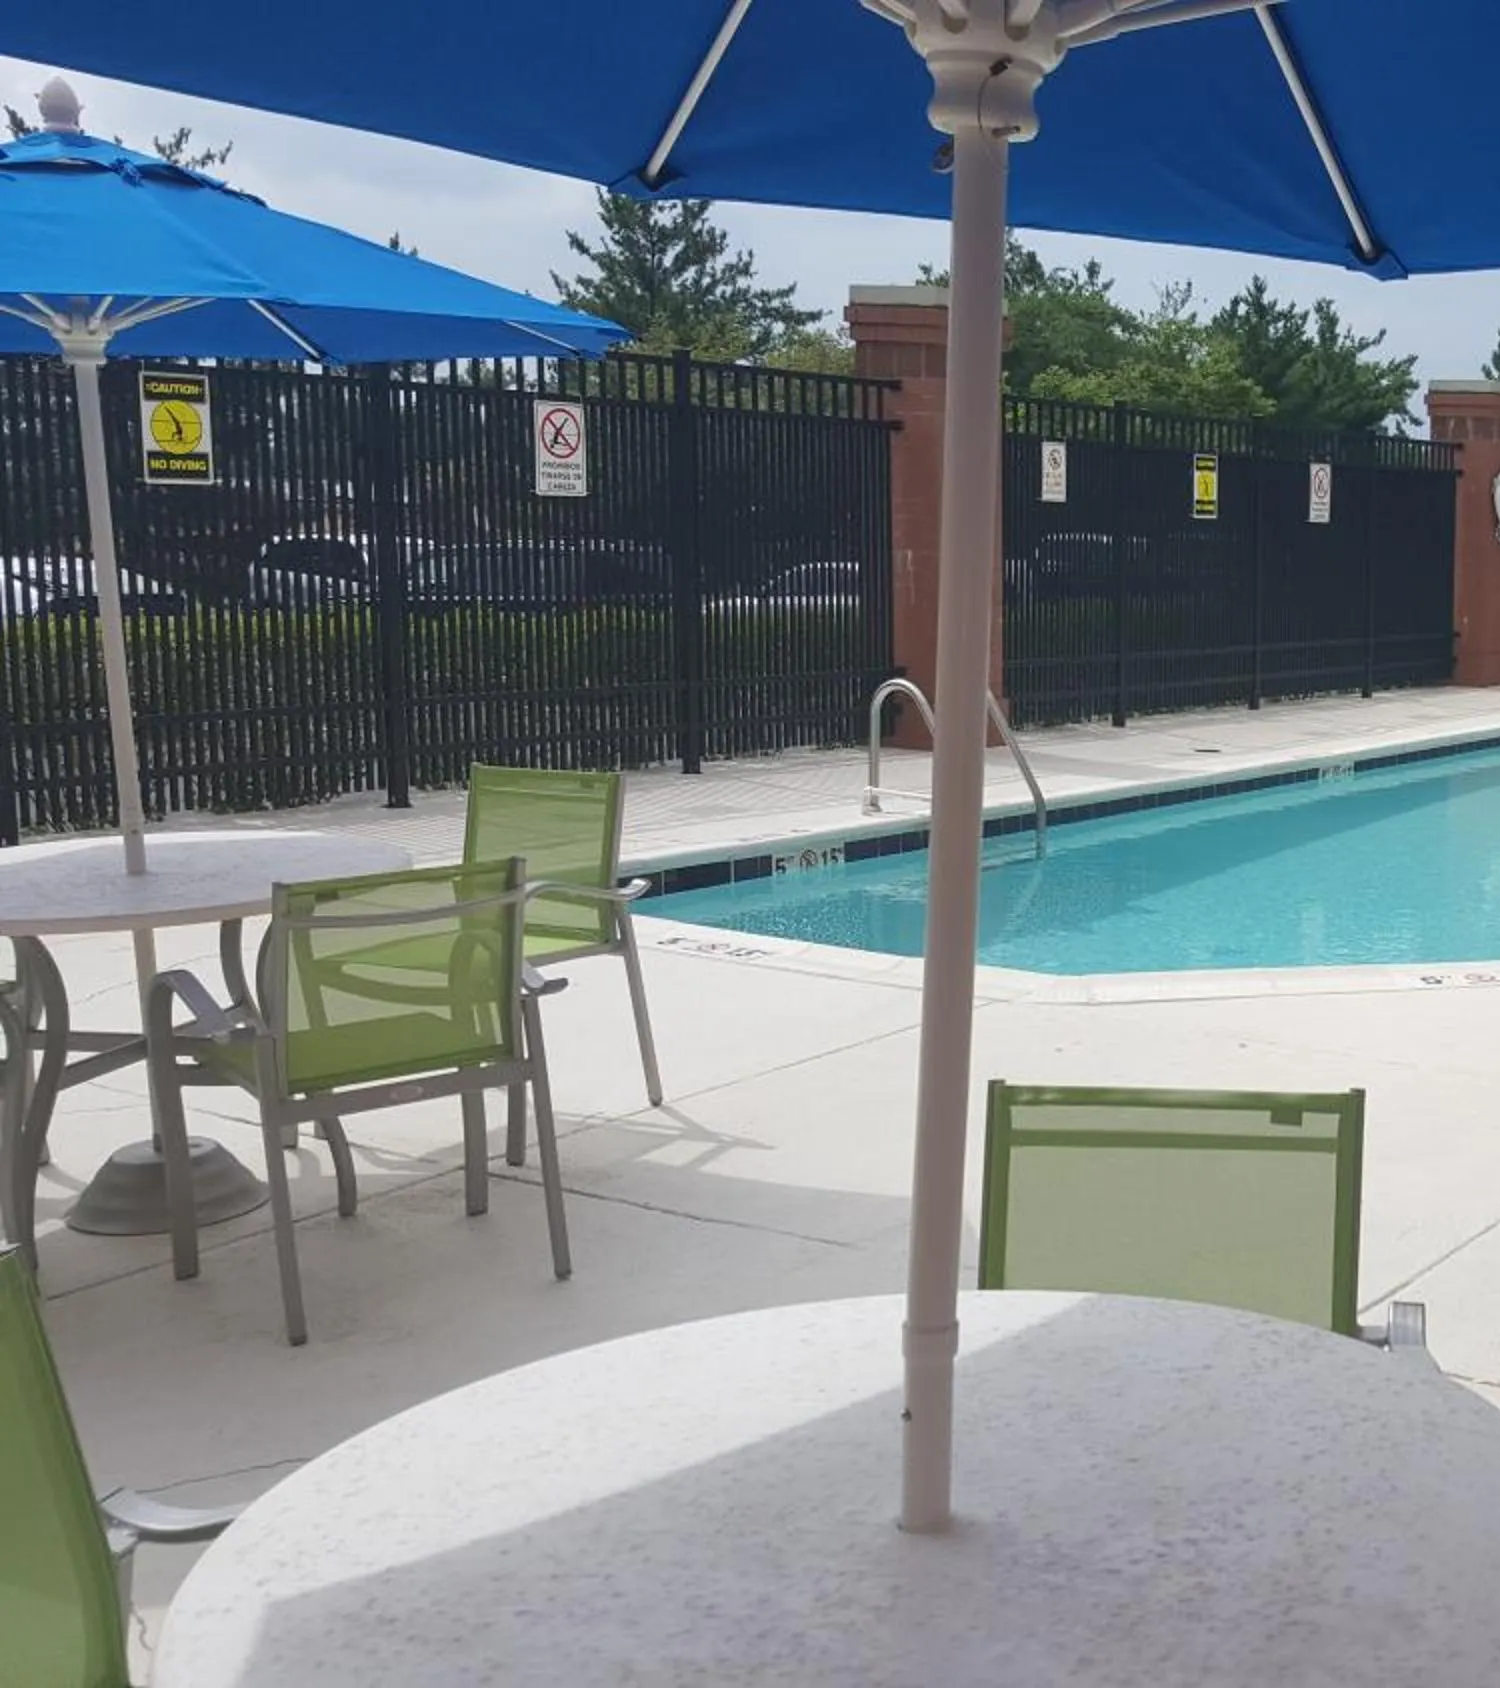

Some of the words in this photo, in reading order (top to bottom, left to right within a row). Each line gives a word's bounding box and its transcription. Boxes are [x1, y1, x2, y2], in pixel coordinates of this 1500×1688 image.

[151, 382, 199, 395] CAUTION
[149, 459, 167, 470] NO
[169, 459, 207, 471] DIVING
